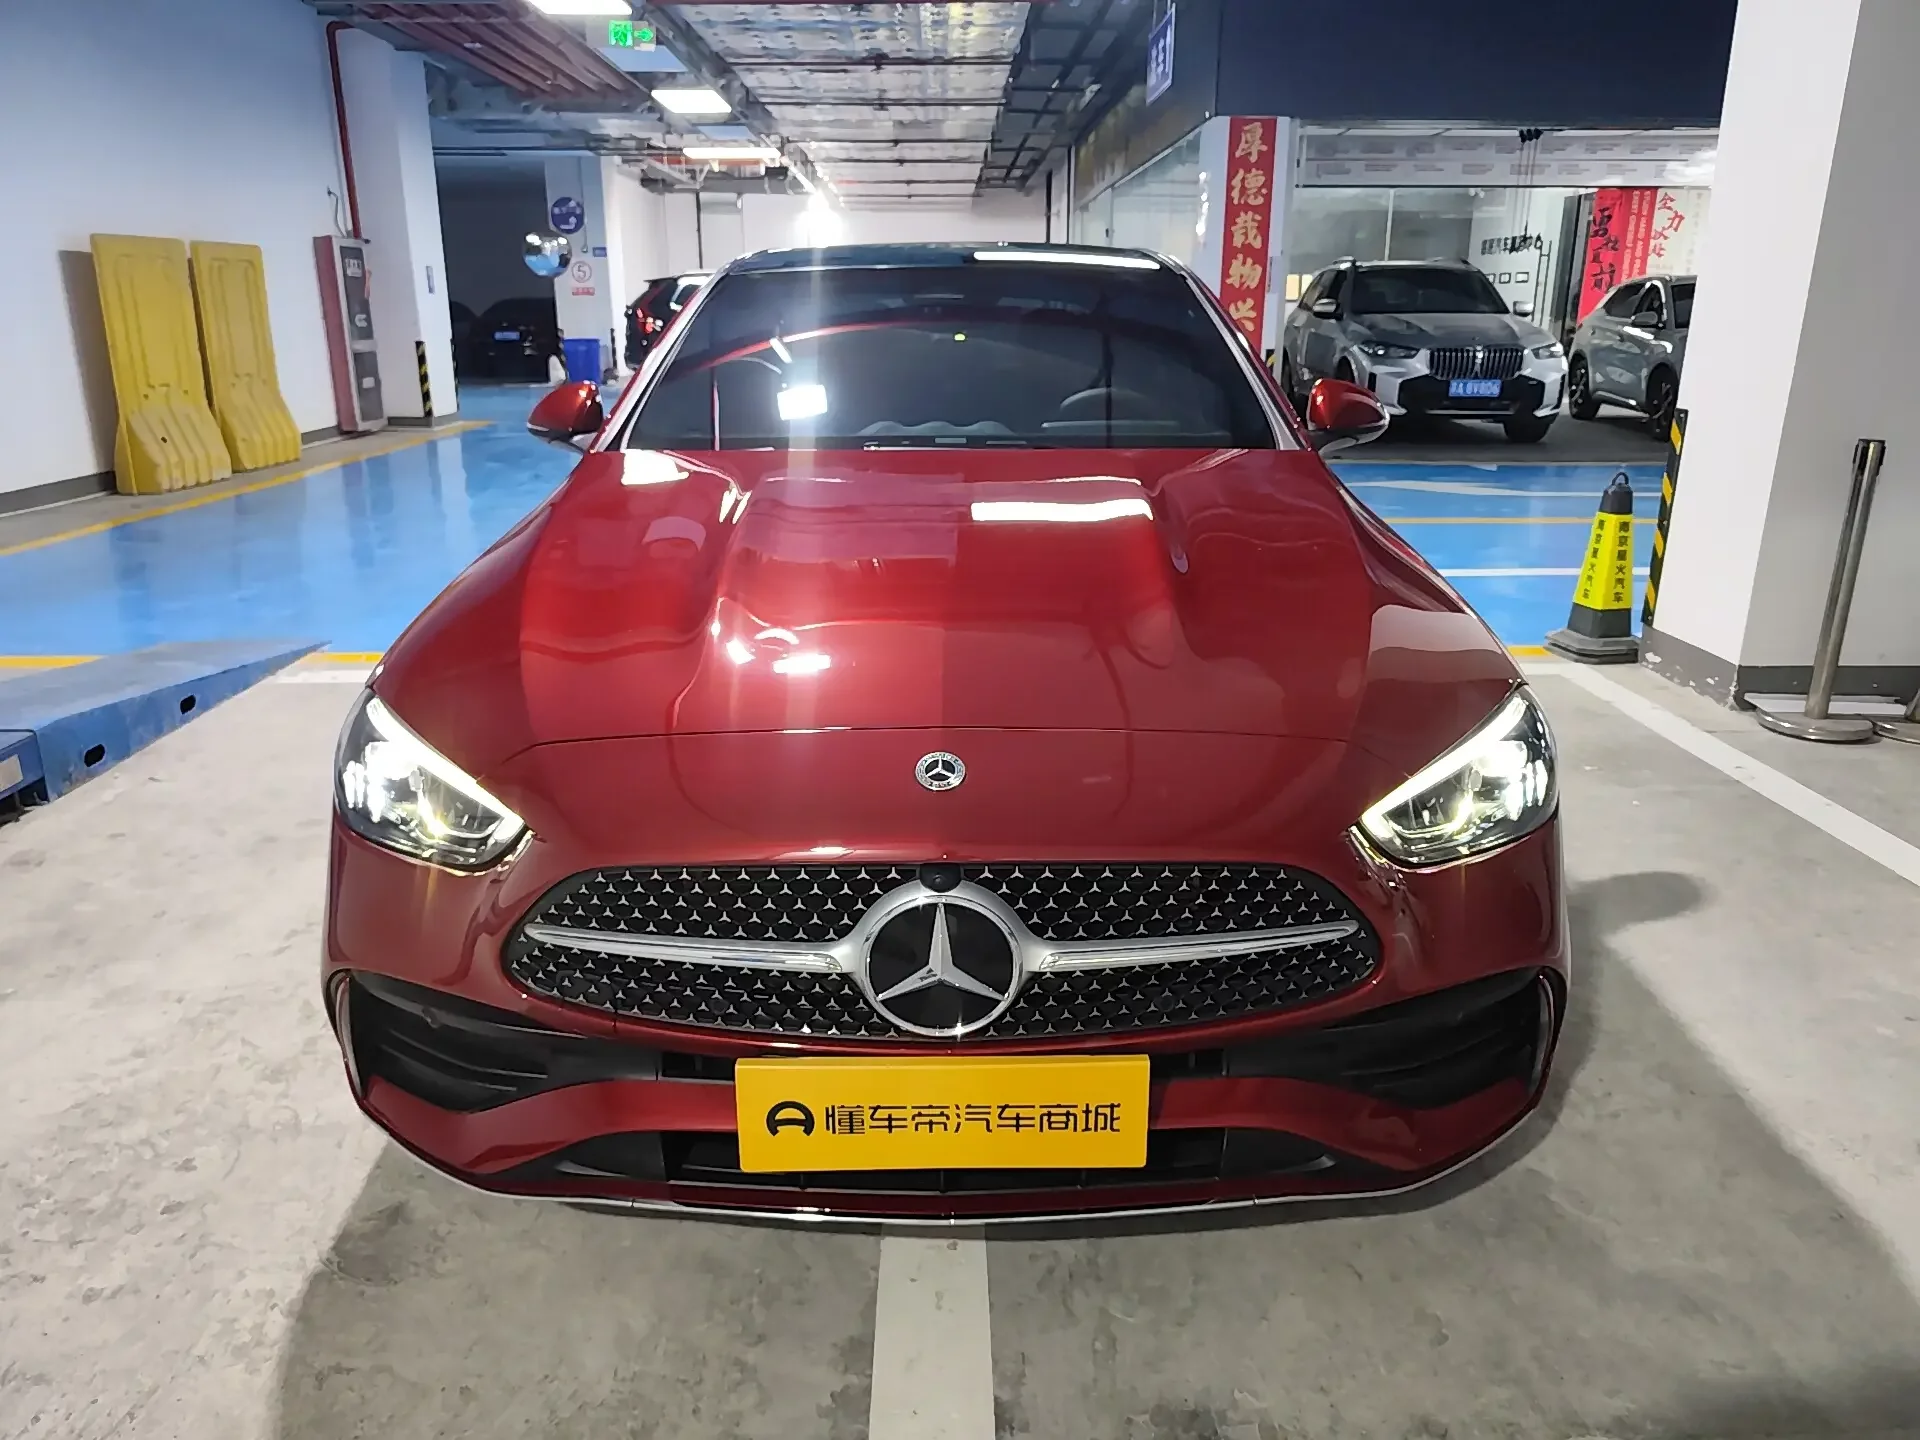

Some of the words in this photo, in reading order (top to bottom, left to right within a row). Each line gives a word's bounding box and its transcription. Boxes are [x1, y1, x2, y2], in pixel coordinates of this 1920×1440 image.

[824, 1101, 1121, 1135] 懂车帝汽车商城
